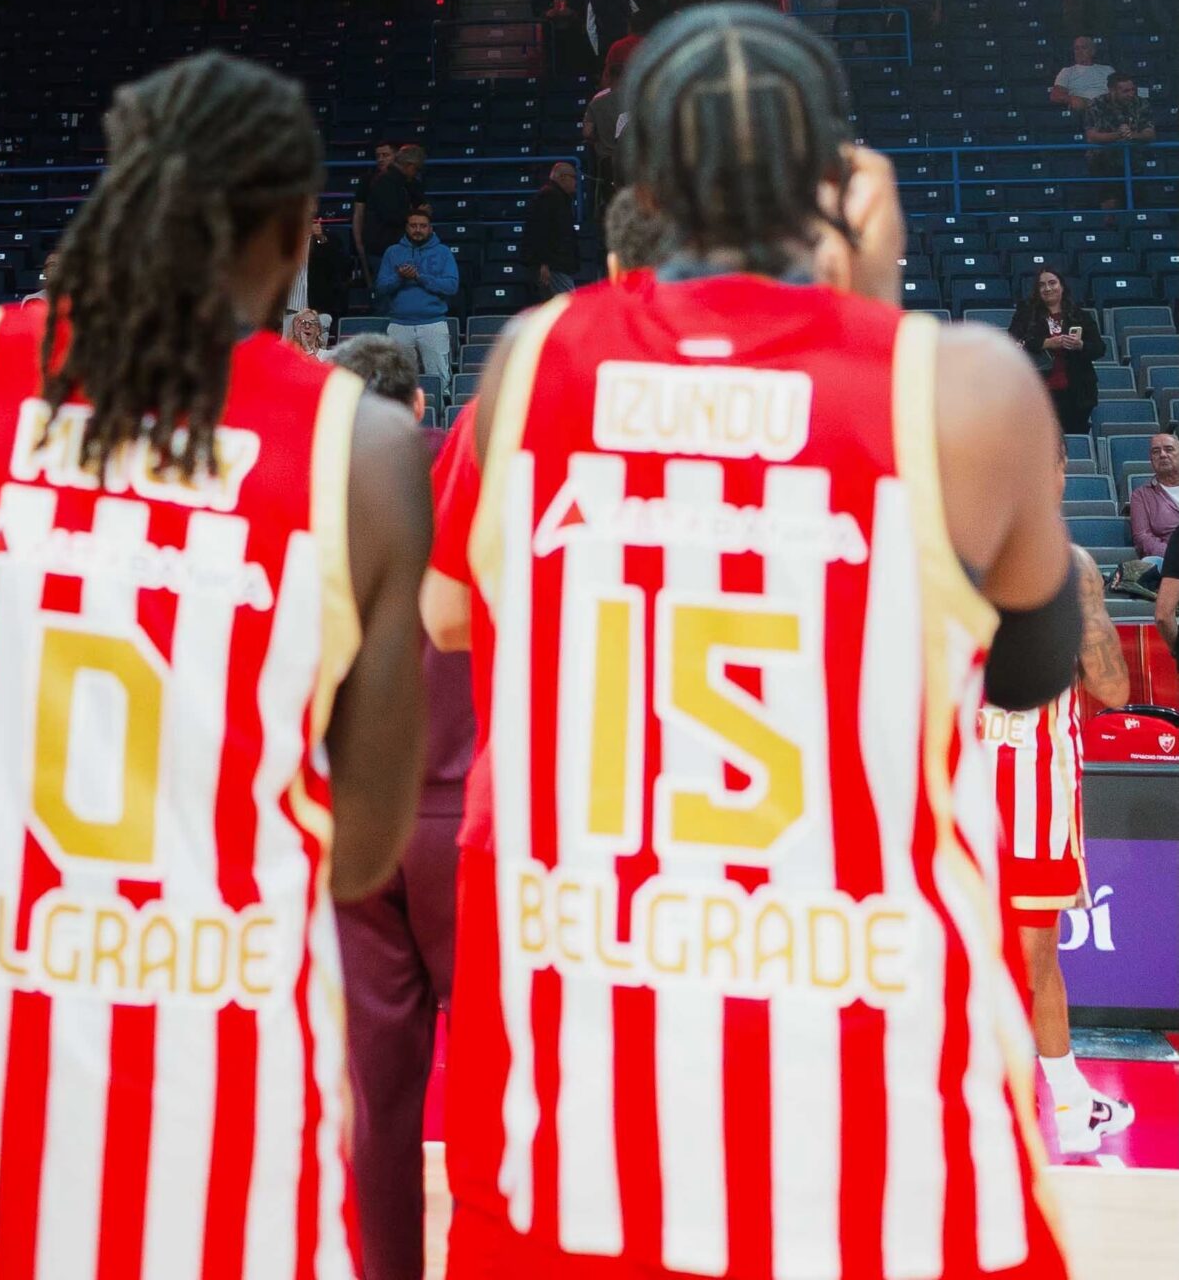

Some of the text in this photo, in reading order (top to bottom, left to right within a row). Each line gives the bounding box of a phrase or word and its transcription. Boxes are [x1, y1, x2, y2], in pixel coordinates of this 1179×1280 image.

[33, 627, 164, 865] 0
[587, 599, 804, 850] 15
[518, 872, 908, 994] BELGRADE
